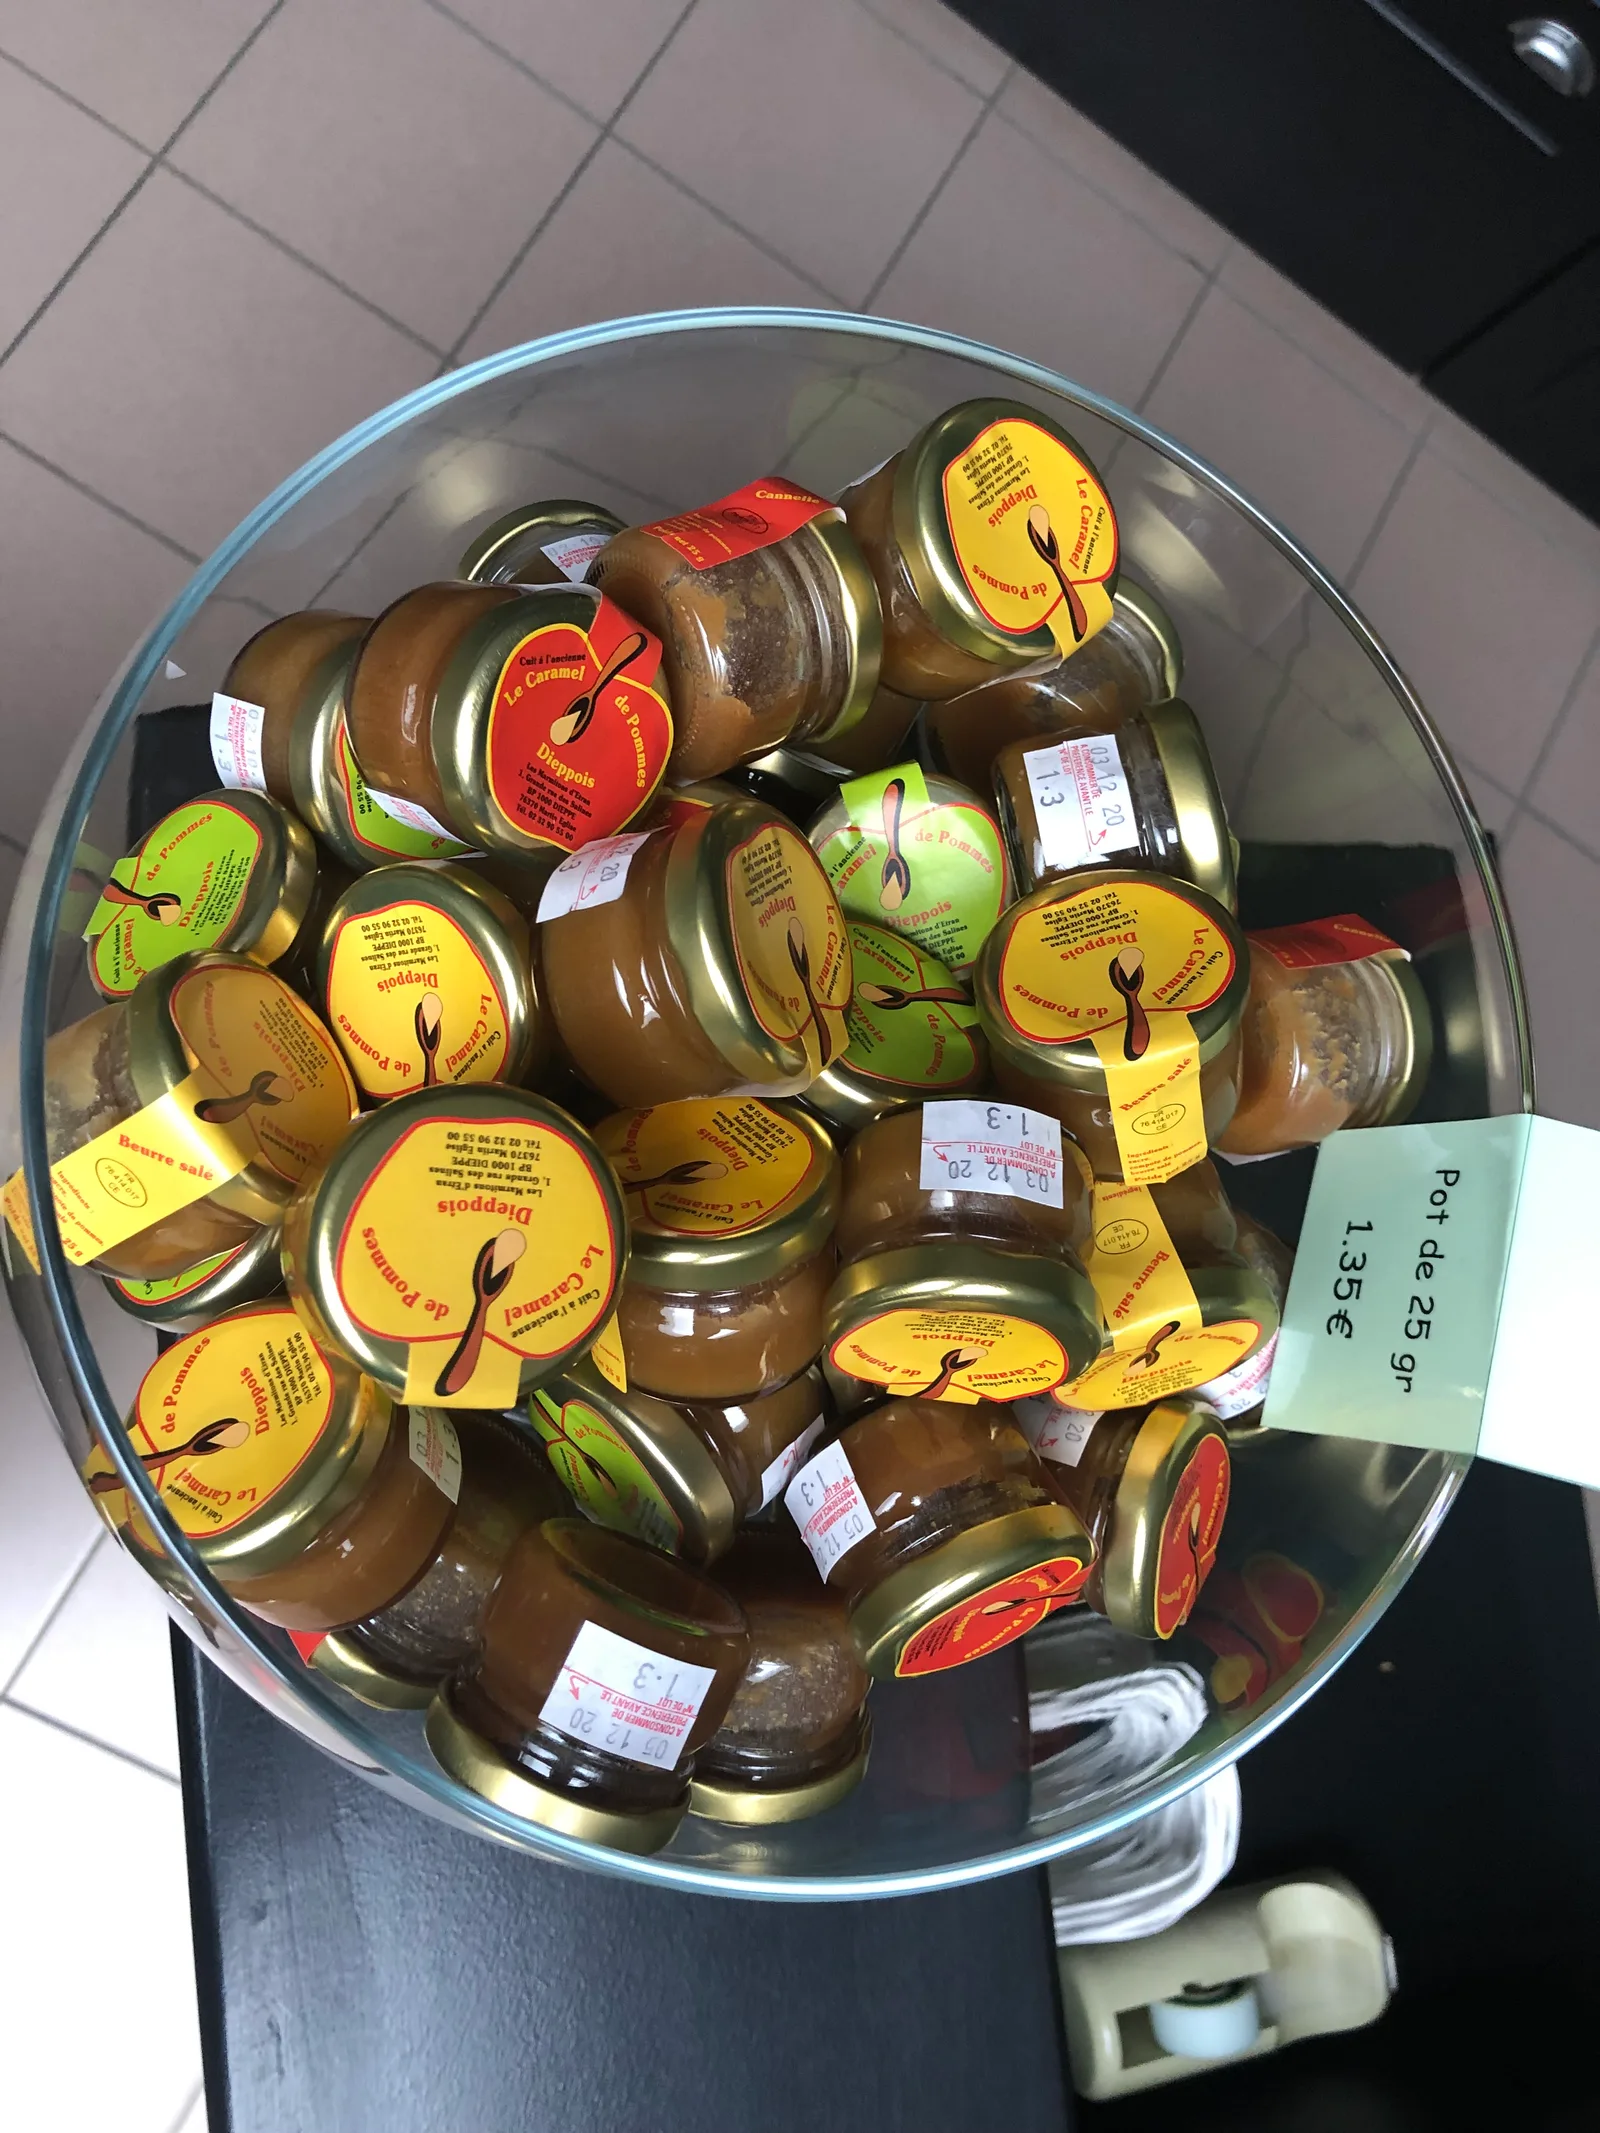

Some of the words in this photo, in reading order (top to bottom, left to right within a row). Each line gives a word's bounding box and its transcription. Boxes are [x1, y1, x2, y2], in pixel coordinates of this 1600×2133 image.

[1075, 478, 1087, 499] Le
[988, 484, 1038, 528] Dieppois
[1069, 504, 1093, 570] Caramel
[972, 565, 1029, 599] Pommes
[1032, 583, 1047, 597] de
[520, 657, 537, 666] Cuit
[504, 685, 523, 706] Le
[526, 666, 586, 687] Caramel
[614, 695, 629, 715] de
[626, 713, 647, 788] Pommes
[536, 742, 595, 788] Dieppois
[1080, 782, 1091, 805] AVANT
[1102, 804, 1125, 826] 20
[146, 864, 161, 881] de
[160, 813, 212, 860] Pommes
[915, 829, 933, 842] de
[938, 830, 995, 873] Pommes
[178, 861, 214, 928] Dieppois
[826, 905, 836, 925] Le
[883, 901, 952, 928] Dieppois
[124, 918, 135, 970] Caramel
[1193, 928, 1209, 945] Le
[1060, 932, 1138, 961] Dieppois
[816, 931, 838, 994] Caramel
[853, 939, 911, 983] Caramel
[1206, 951, 1223, 965] Cuit
[134, 967, 147, 982] Le
[377, 970, 438, 993] Dieppois
[1152, 948, 1205, 1001] Caramel
[1165, 971, 1204, 1005] l'ancienne
[480, 994, 492, 1016] Le
[1013, 984, 1079, 1018] Pommes
[927, 1014, 940, 1030] de
[1086, 1007, 1109, 1019] de
[338, 1014, 389, 1070] Pommes
[445, 1020, 488, 1072] Caramel
[486, 1030, 501, 1047] Cuit
[394, 1062, 411, 1076] de
[1119, 1083, 1166, 1111] Beurre
[1167, 1058, 1192, 1082] salé
[447, 1132, 459, 1140] 00
[464, 1133, 475, 1141] 55
[478, 1135, 490, 1143] 90
[494, 1137, 506, 1145] 32
[509, 1138, 521, 1147] 02
[1020, 1140, 1034, 1150] LOT
[119, 1134, 174, 1166] Beurre
[179, 1162, 213, 1180] salé
[446, 1143, 473, 1154] Eglise
[478, 1147, 507, 1158] Martin
[511, 1151, 540, 1161] 76370
[697, 1128, 749, 1171] Dieppois
[967, 1144, 976, 1152] LE
[979, 1146, 1006, 1155] AVANT
[1036, 1145, 1044, 1154] DE
[452, 1156, 488, 1168] DIEPPE
[492, 1161, 515, 1170] 1000
[519, 1164, 532, 1172] BP
[985, 1155, 995, 1164] DE
[429, 1167, 464, 1178] Salines
[467, 1170, 484, 1179] des
[506, 1173, 539, 1185] Grande
[949, 1160, 972, 1179] 20
[1051, 1170, 1056, 1178] A
[474, 1183, 523, 1196] Marmitons
[527, 1188, 542, 1197] Les
[1426, 1169, 1460, 1225] Pot
[437, 1196, 533, 1225] Dieppois
[741, 1199, 764, 1209] Le
[580, 1244, 604, 1270] Le
[1416, 1239, 1445, 1281] de
[362, 1227, 421, 1308] Pommes
[1132, 1250, 1170, 1291] Beurre
[505, 1272, 584, 1326] Caramel
[577, 1289, 600, 1305] Cuit
[1113, 1291, 1135, 1319] salé
[424, 1302, 450, 1321] de
[1404, 1296, 1435, 1339] 25
[511, 1306, 568, 1338] l'ancienne
[912, 1334, 996, 1347] Dieppois
[850, 1344, 898, 1373] Pommes
[1037, 1360, 1058, 1368] Le
[163, 1337, 211, 1407] Pommes
[901, 1369, 921, 1377] de
[968, 1367, 1038, 1382] Caramel
[1391, 1353, 1415, 1393] gr
[240, 1367, 269, 1435] Dieppois
[161, 1413, 176, 1433] de
[174, 1468, 231, 1506] Caramel
[237, 1487, 257, 1501] Le
[601, 1690, 612, 1700] LE
[656, 1697, 668, 1705] LOT
[612, 1696, 642, 1714] AVANT
[612, 1709, 624, 1718] DE
[668, 1701, 682, 1710] DE
[569, 1708, 597, 1734] 20
[675, 1729, 683, 1737] A
